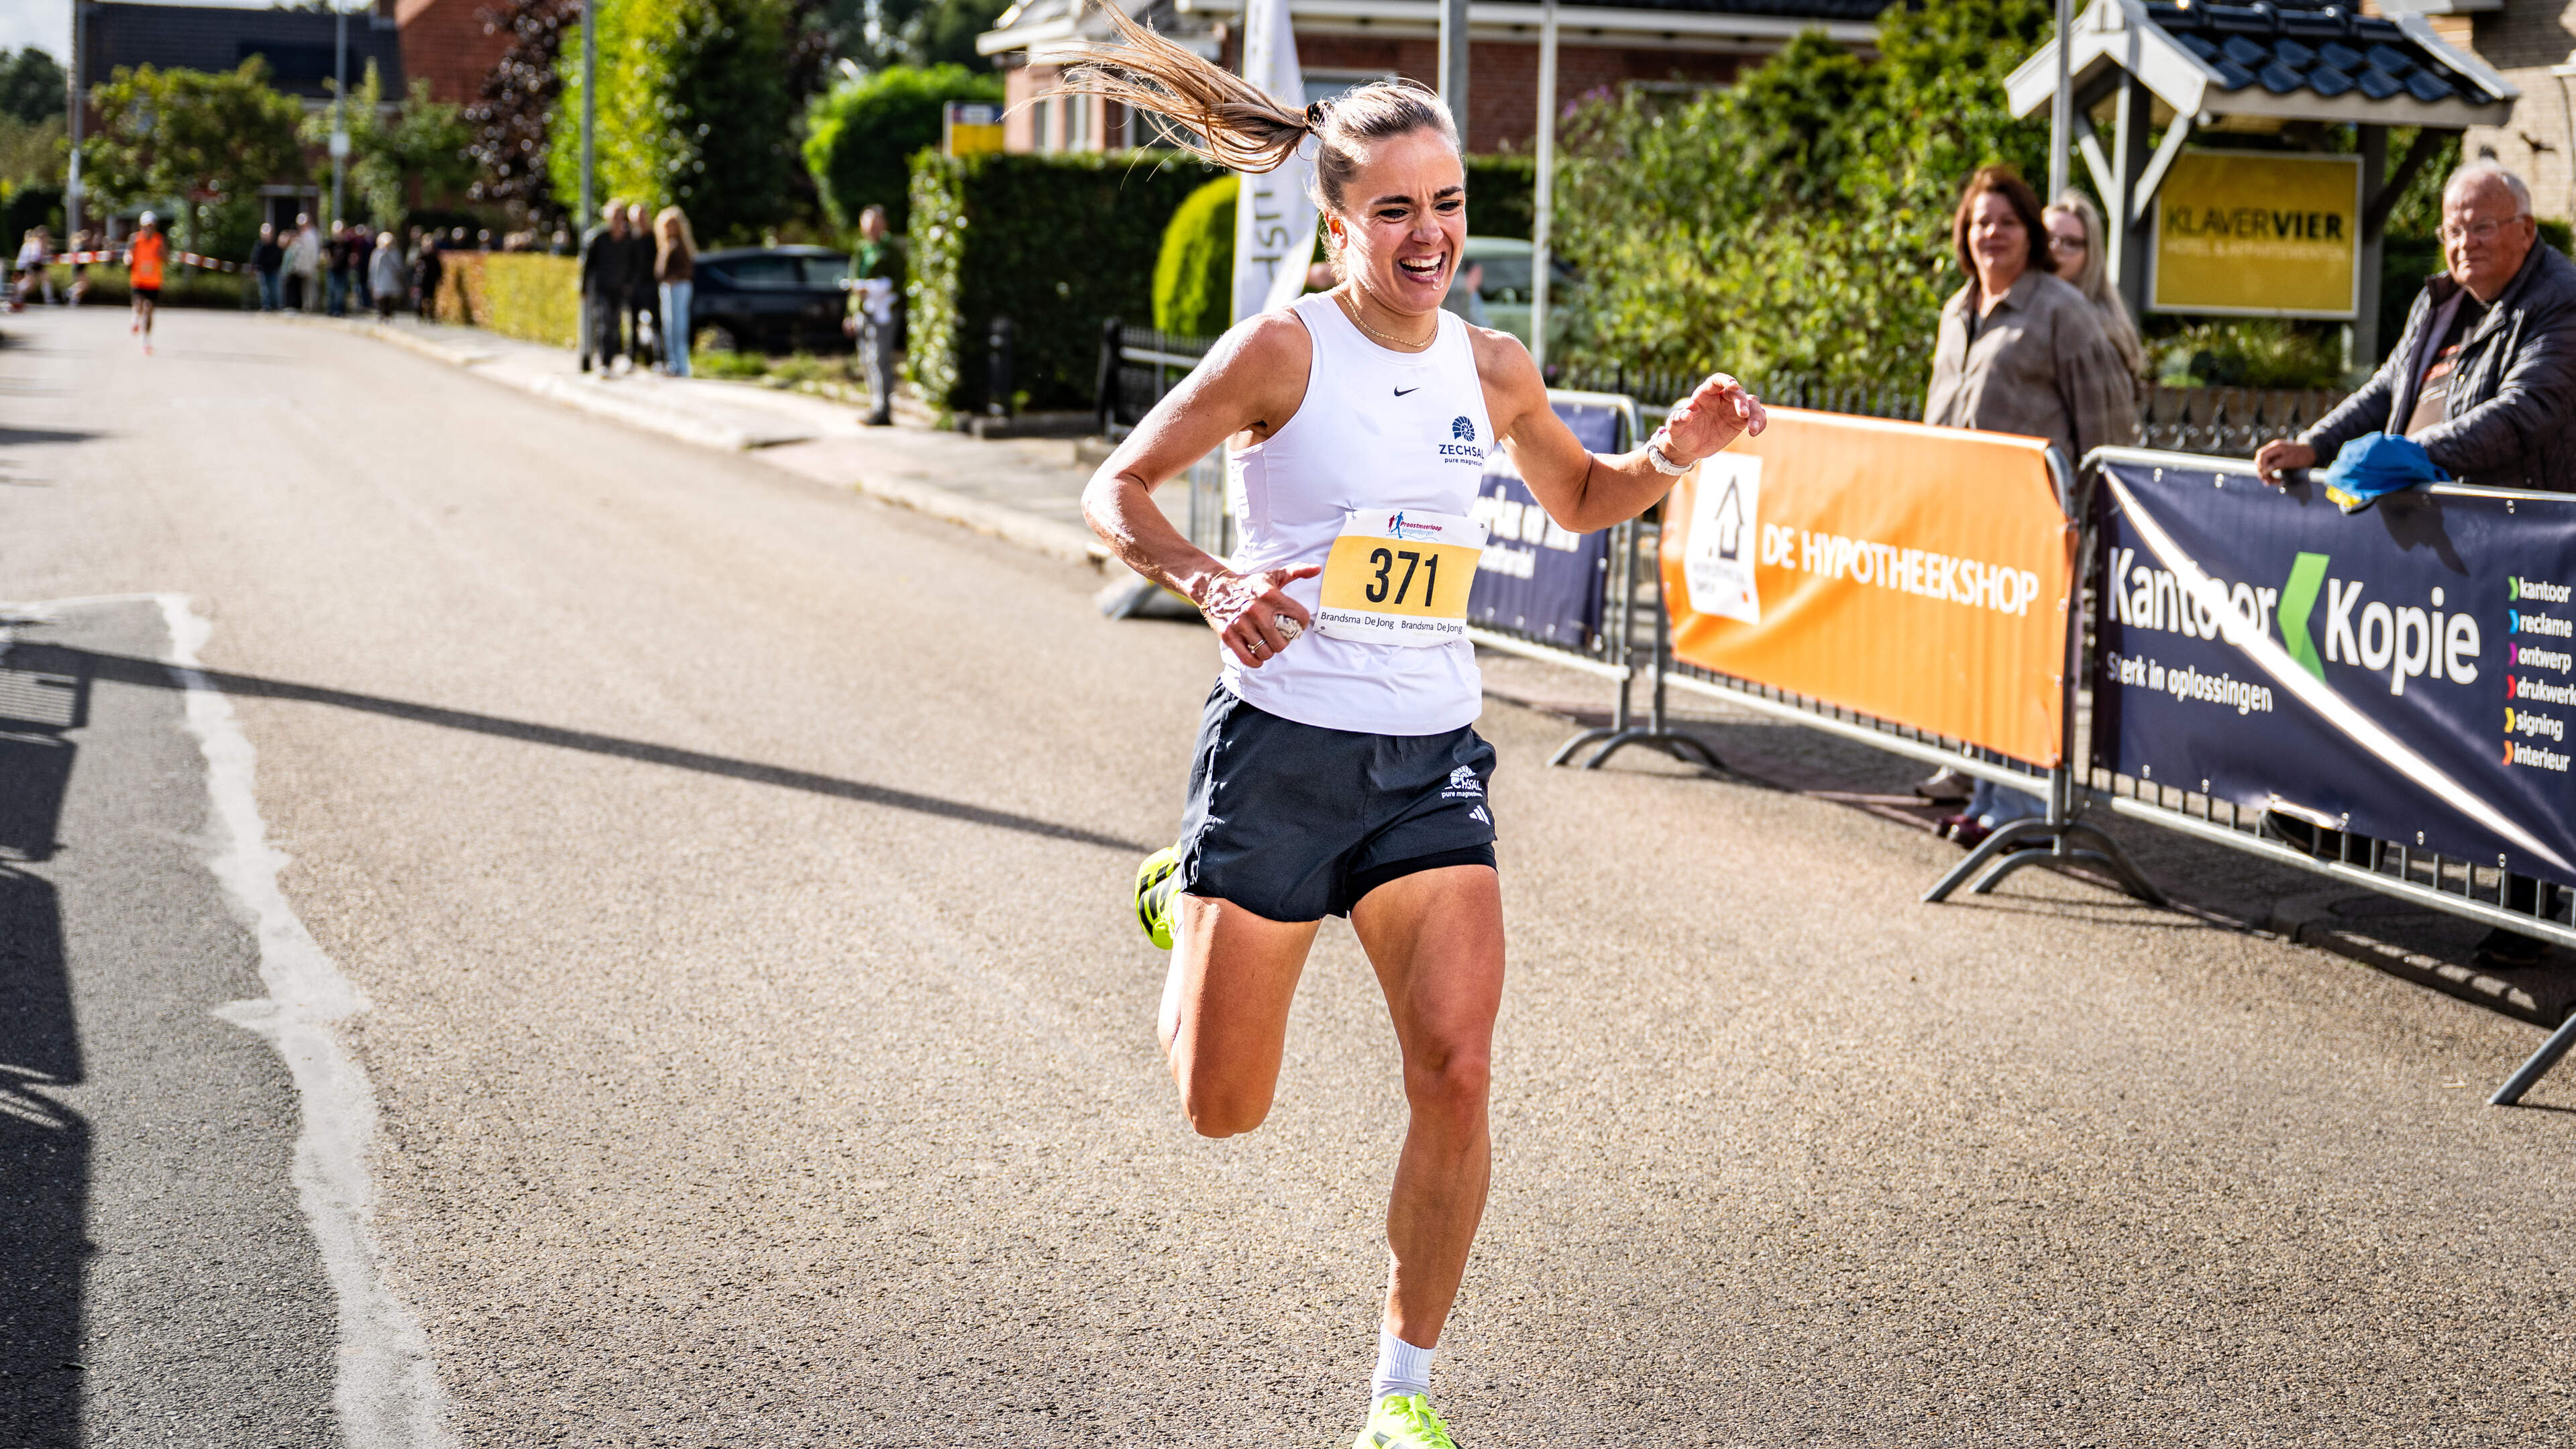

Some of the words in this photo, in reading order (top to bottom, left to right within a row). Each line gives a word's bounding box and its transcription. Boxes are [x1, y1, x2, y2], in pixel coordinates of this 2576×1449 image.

[2166, 206, 2344, 239] KLAVERVIER
[1439, 444, 1484, 460] ZECHSAL
[1400, 521, 1442, 532] Proostmeerloop
[1366, 548, 1438, 606] 371
[1762, 523, 1796, 569] DE
[1801, 530, 2039, 617] HYPOTHEEKSHOP
[2519, 576, 2571, 603] kantoor
[1321, 612, 1360, 624] Brandsma
[1401, 621, 1434, 631] Brandsma
[2108, 546, 2277, 645] Kantoor
[2324, 578, 2480, 696] Kopie
[2519, 612, 2573, 638] reclame
[2518, 646, 2572, 675] ontwerp
[2149, 659, 2165, 691] in
[2167, 665, 2273, 715] oplossingen
[2516, 710, 2563, 741] signing
[2514, 741, 2571, 772] interieur
